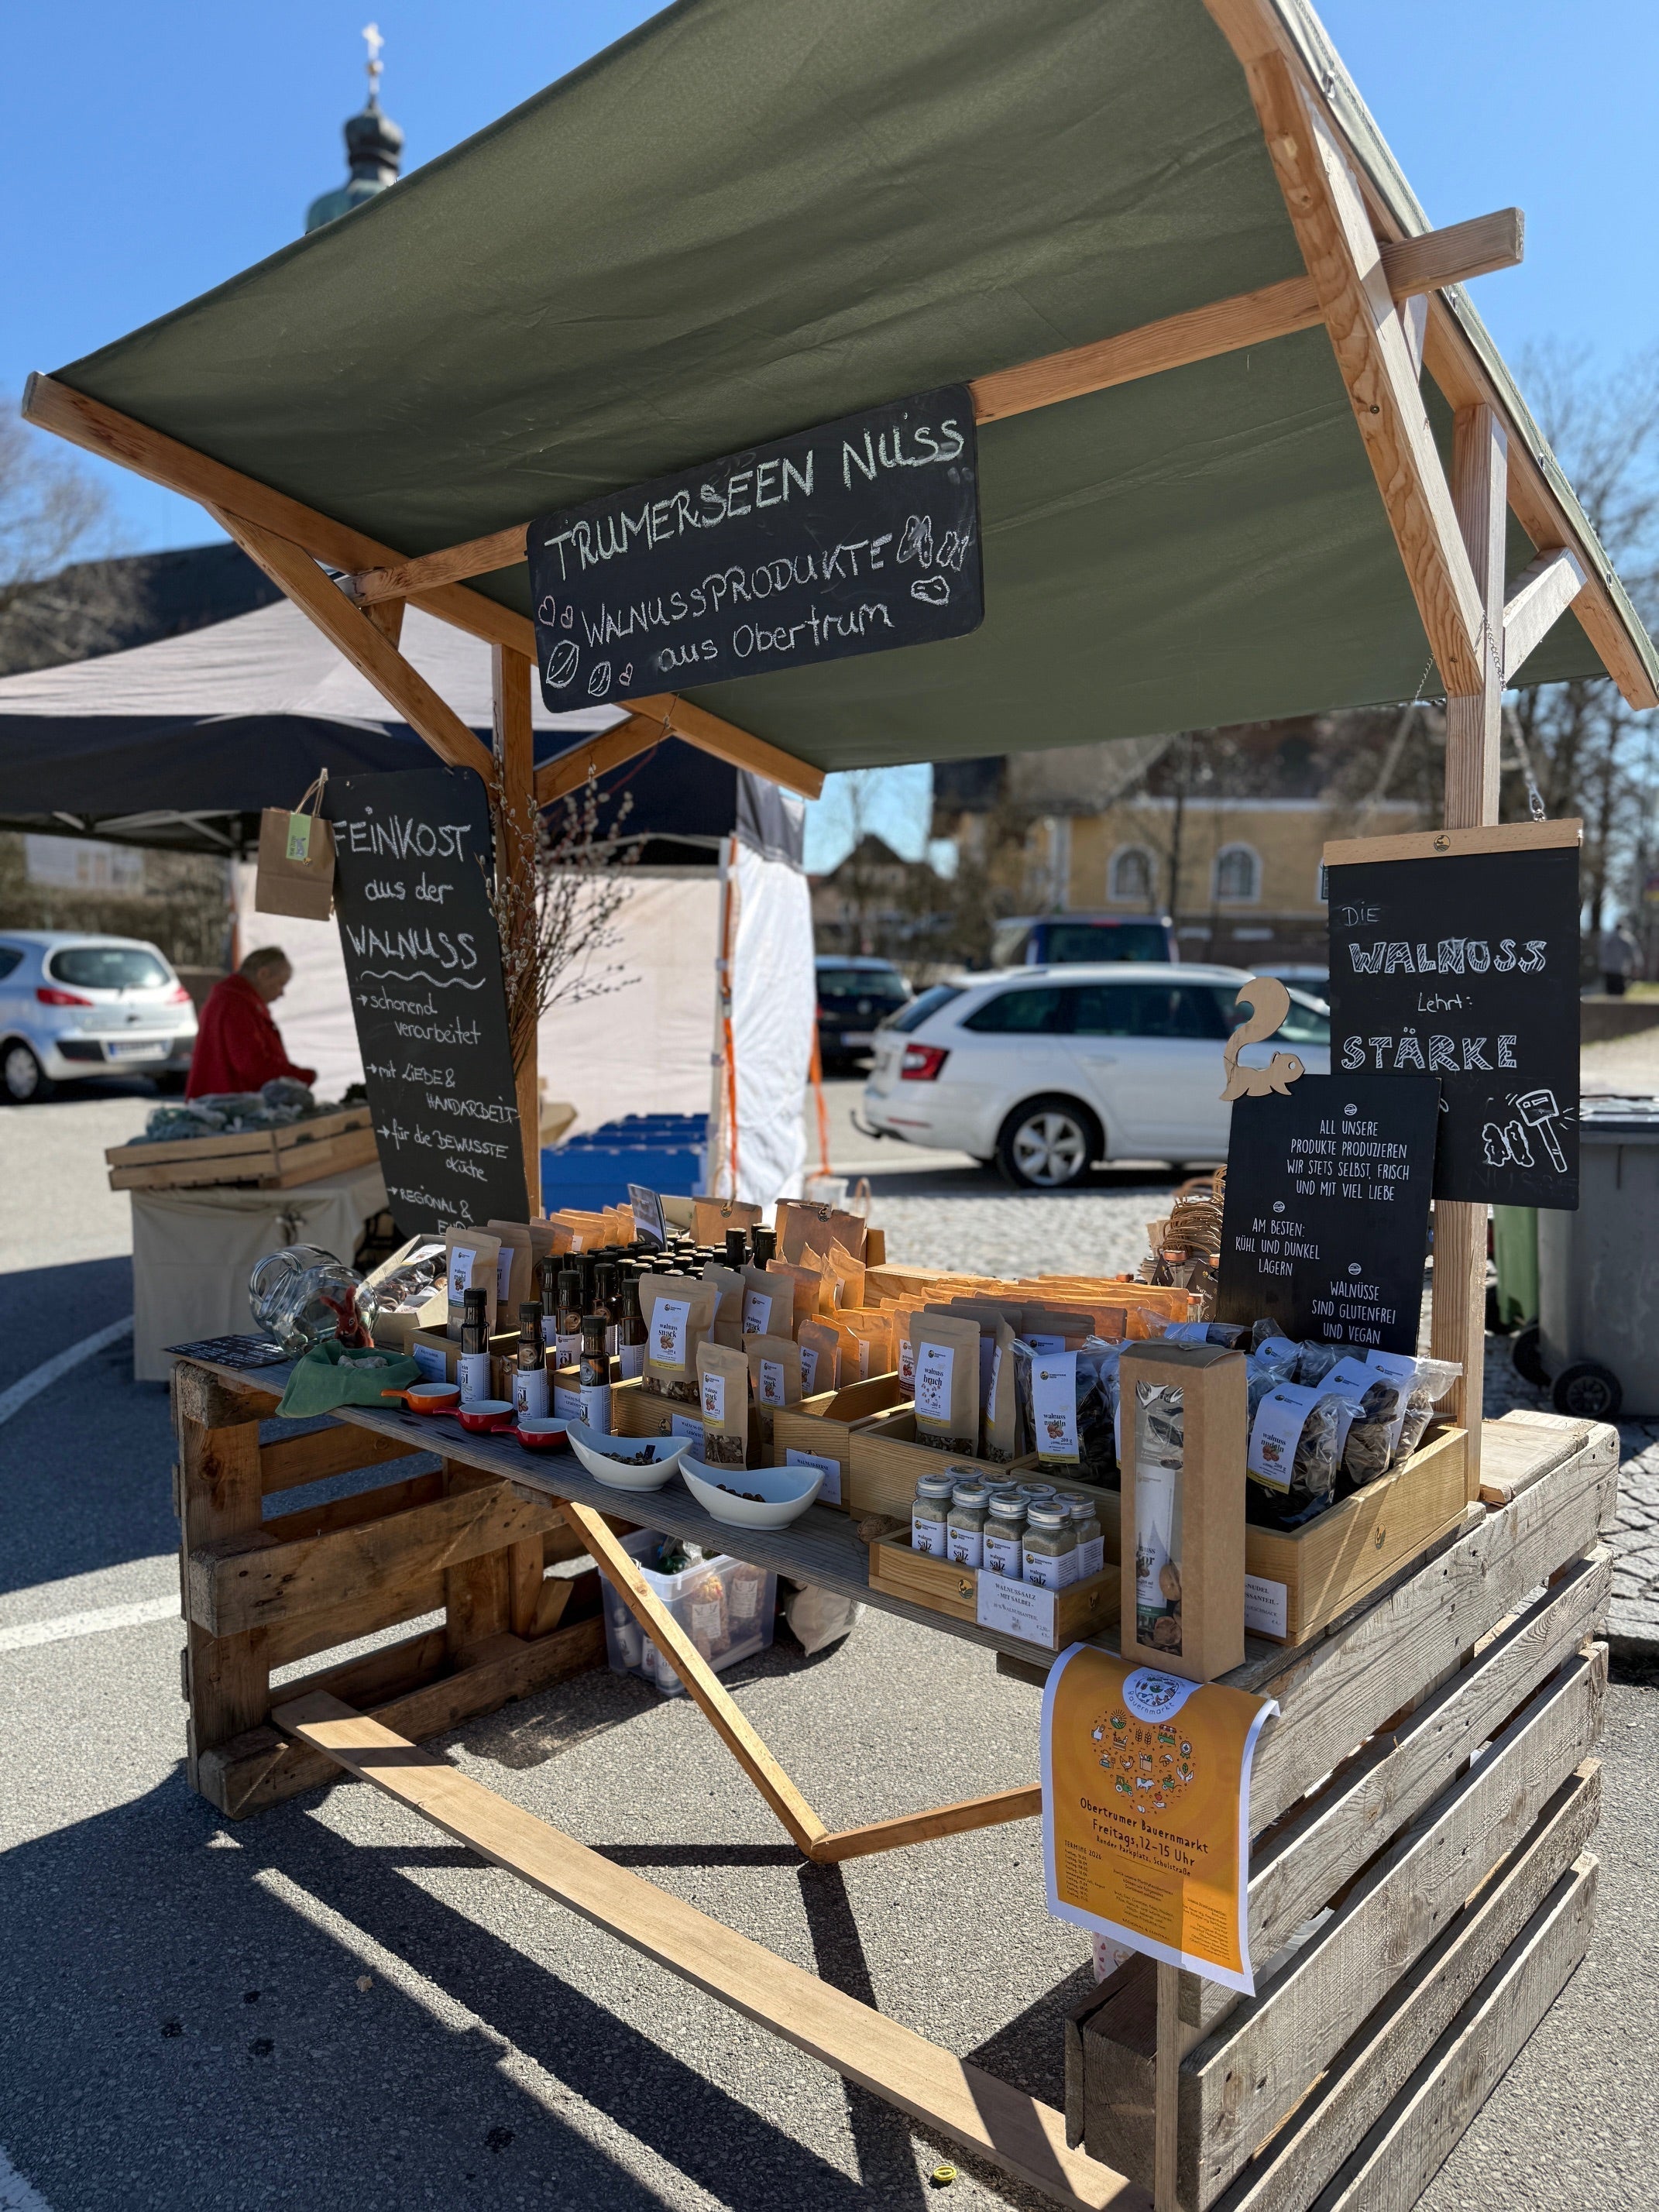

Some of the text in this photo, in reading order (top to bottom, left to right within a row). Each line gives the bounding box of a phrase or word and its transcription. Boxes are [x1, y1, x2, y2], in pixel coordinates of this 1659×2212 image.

[545, 450, 813, 580] TRUMERSEEN
[582, 533, 892, 646] WALNUSSPRODUKTE
[658, 603, 894, 672] aus Obertrum
[365, 873, 454, 904] aus der
[347, 925, 477, 969] WALNUSS
[1349, 937, 1548, 976] WALNUSS
[371, 986, 438, 1016] schonend
[394, 1016, 481, 1044] verarbeitet
[1341, 1027, 1517, 1071] STÄRKE
[379, 1060, 396, 1078] mit
[445, 1068, 455, 1087] &
[392, 1119, 508, 1158] für die BEWUSSTE
[1320, 1119, 1378, 1137] ALL UNSERE
[1291, 1138, 1407, 1159] PRODUKTE PRODUZIEREN
[1286, 1159, 1409, 1181] WIR STETS SELBST, FRISCH
[1296, 1180, 1395, 1202] UND MIT VIEL LIEBE
[461, 1200, 473, 1221] &
[1252, 1219, 1305, 1238] AM BESTEN:
[1235, 1234, 1320, 1260] KÜHL UND DUNKEL
[1259, 1258, 1293, 1276] LAGERN
[1330, 1280, 1379, 1301] WALNÜSSE
[1312, 1299, 1396, 1324] SIND GLUTENFREI
[659, 1330, 677, 1338] snack
[1323, 1322, 1381, 1345] UND VEGAN
[924, 1368, 944, 1376] walnuss
[924, 1375, 942, 1386] bruch
[1261, 1440, 1284, 1453] nudeln
[1263, 1432, 1286, 1445] walnuss
[917, 1540, 932, 1550] salz
[953, 1550, 969, 1560] salz
[990, 1560, 1005, 1570] salz
[995, 1583, 1036, 1600] WALNUSS-SALZ
[1030, 1575, 1046, 1586] salz
[1011, 1597, 1031, 1607] SALBEI
[1128, 1690, 1175, 1715] Bauernmarkt
[1080, 1797, 1209, 1854] Obertrumer Bauernmarkt
[1065, 1840, 1087, 1855] TERMINE
[1093, 1819, 1139, 1848] Freitags,
[1175, 1849, 1195, 1867] Uhr
